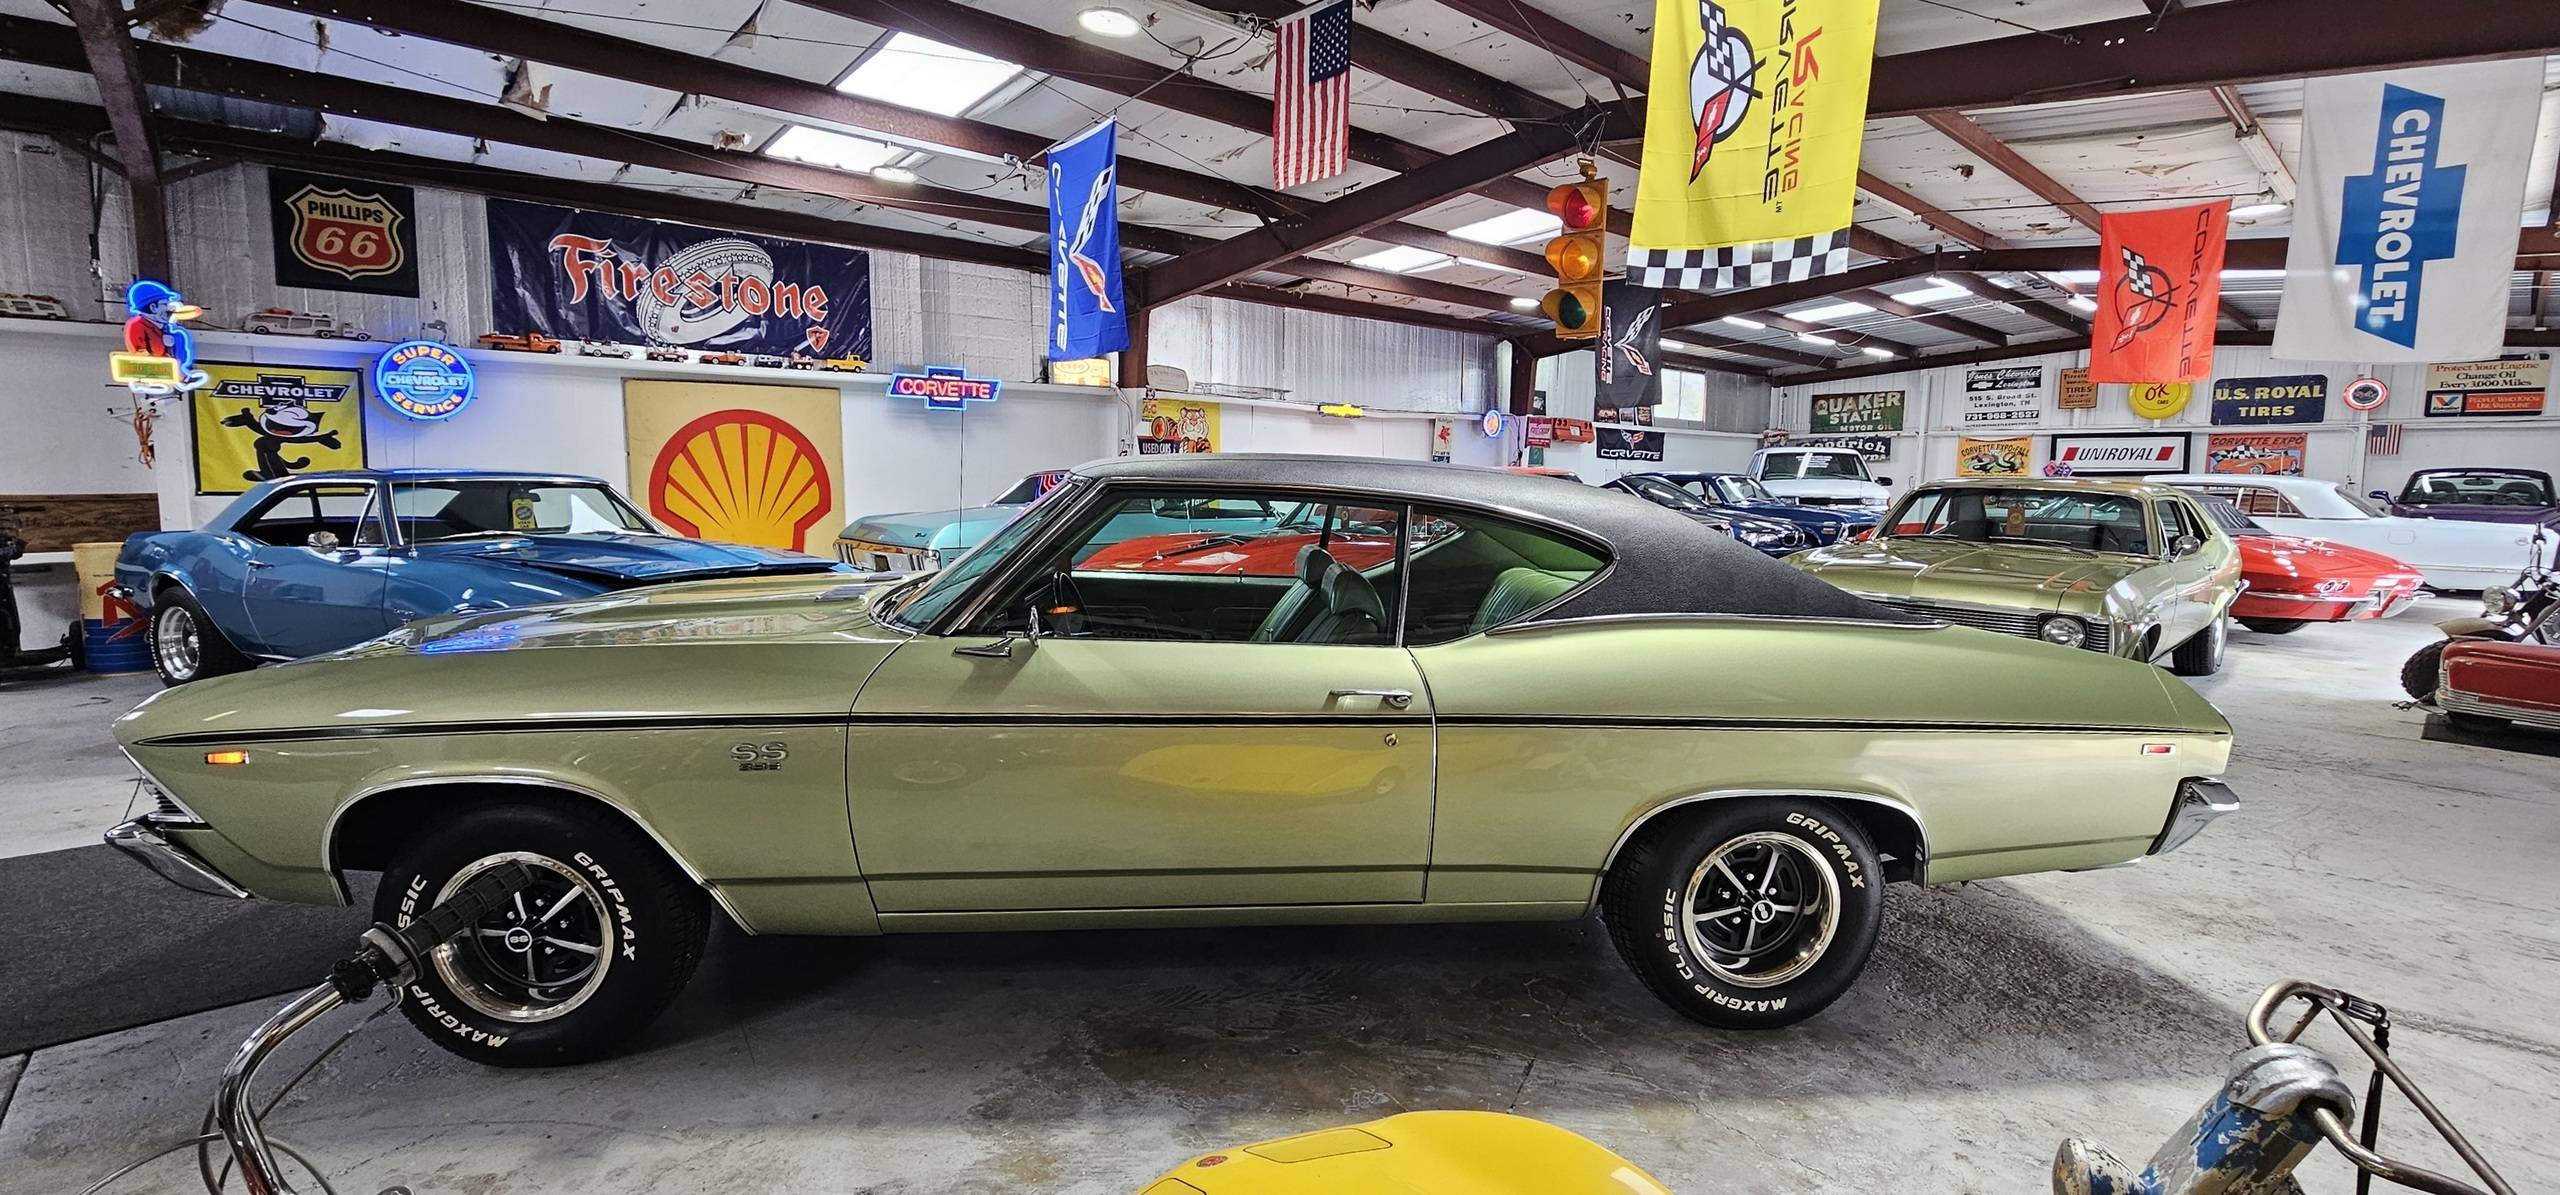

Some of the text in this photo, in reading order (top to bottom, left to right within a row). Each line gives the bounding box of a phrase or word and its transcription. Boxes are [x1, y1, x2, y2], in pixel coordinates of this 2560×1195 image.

[306, 200, 385, 225] PHILLIPS
[2368, 108, 2431, 322] CHEVROLET
[315, 226, 380, 260] 66
[548, 233, 829, 322] Firestone
[1604, 305, 1613, 385] CORVETTE
[392, 345, 456, 366] SUPER
[2435, 361, 2540, 372] Protect Your Engine
[2456, 370, 2517, 380] Change Oil
[386, 374, 465, 387] CHEVROLET
[895, 377, 991, 399] CORVETTE
[2440, 380, 2469, 389] Every
[2500, 378, 2532, 387] Miles
[226, 383, 335, 400] CHEVROLET
[2215, 384, 2325, 401] U.S. ROYAL
[392, 391, 463, 415] SERVICE
[1814, 391, 1901, 416] QUAKER
[2238, 405, 2295, 417] TIRES
[1829, 409, 1882, 425] STATE
[1840, 424, 1873, 432] MOTOR
[1142, 442, 1159, 454] USED
[1961, 443, 1995, 457] CORVETTE
[2211, 435, 2304, 446] CORVETTE EXPO
[1601, 448, 1661, 460] CORVETTE
[2078, 447, 2154, 461] UNIROYAL
[730, 741, 788, 761] SS
[1786, 811, 1866, 889] GRIPMAX
[397, 874, 428, 930] SSIC
[573, 851, 636, 961] GRIPMAX
[1663, 887, 1788, 1013] MAXGRIP CLASSIC
[410, 983, 510, 1048] MAXGRIP
